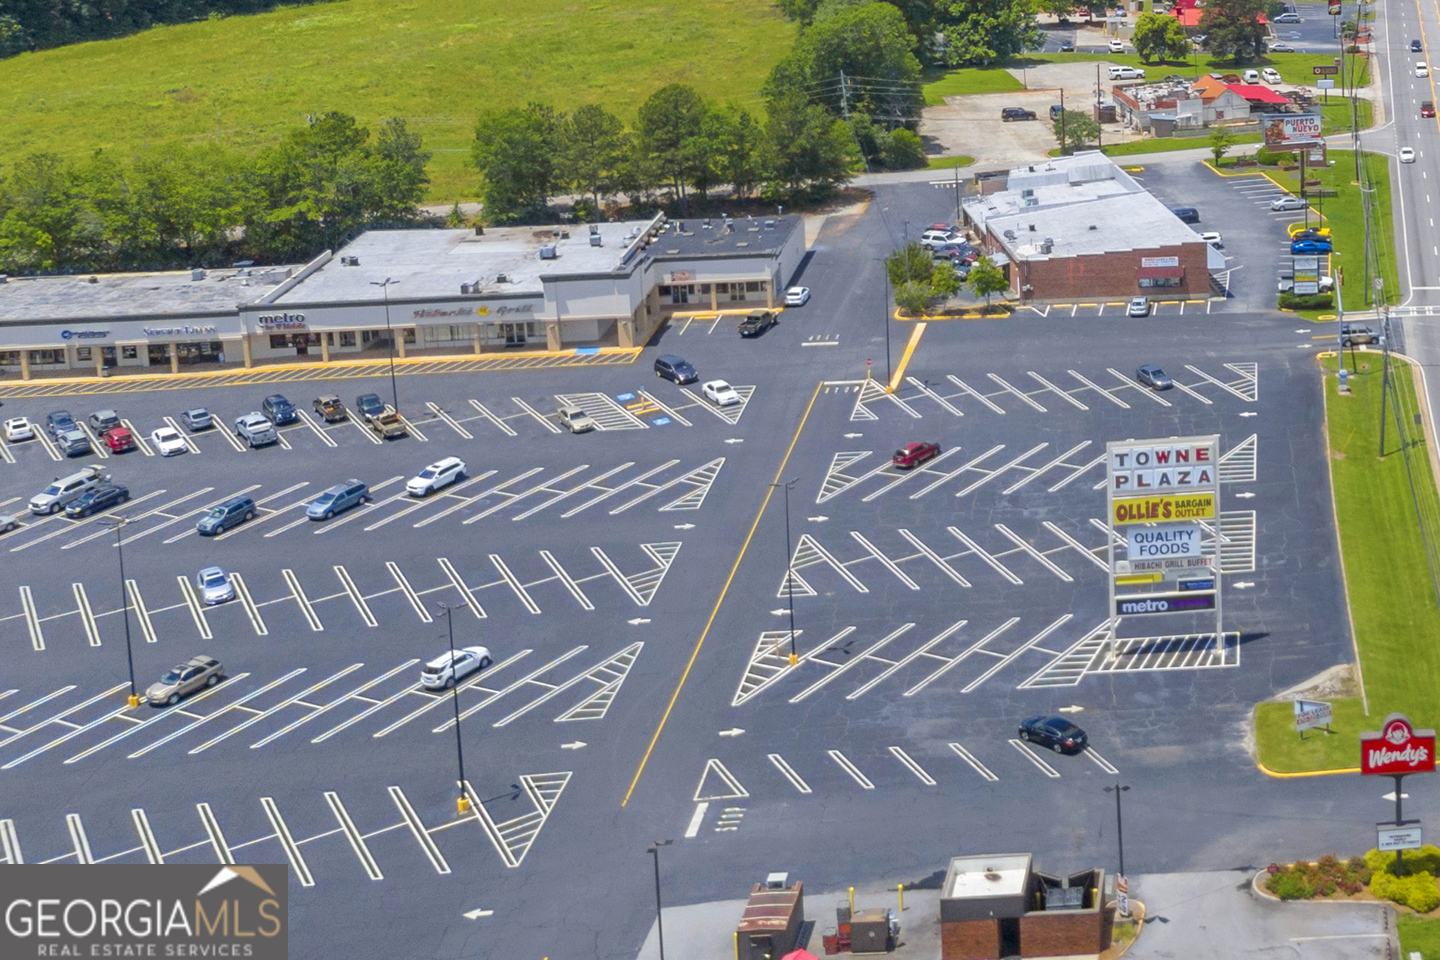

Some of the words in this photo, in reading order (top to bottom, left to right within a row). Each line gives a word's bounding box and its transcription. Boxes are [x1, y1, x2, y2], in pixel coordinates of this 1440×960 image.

[259, 312, 305, 324] metro
[1285, 318, 1314, 326] PUERTO
[1292, 325, 1319, 333] NUEVO
[1115, 447, 1210, 466] TOWNE
[1115, 470, 1211, 489] PLAZA
[1175, 498, 1211, 508] BARGAIN
[1175, 508, 1206, 518] OUTLET
[1134, 530, 1194, 544] QUALITY
[1139, 543, 1190, 556] FOODS
[1134, 562, 1162, 570] HIBACHI
[1164, 560, 1184, 568] GRILL
[1187, 557, 1212, 566] BUFFET
[1122, 599, 1168, 612] metro
[1368, 744, 1428, 768] Wendy's
